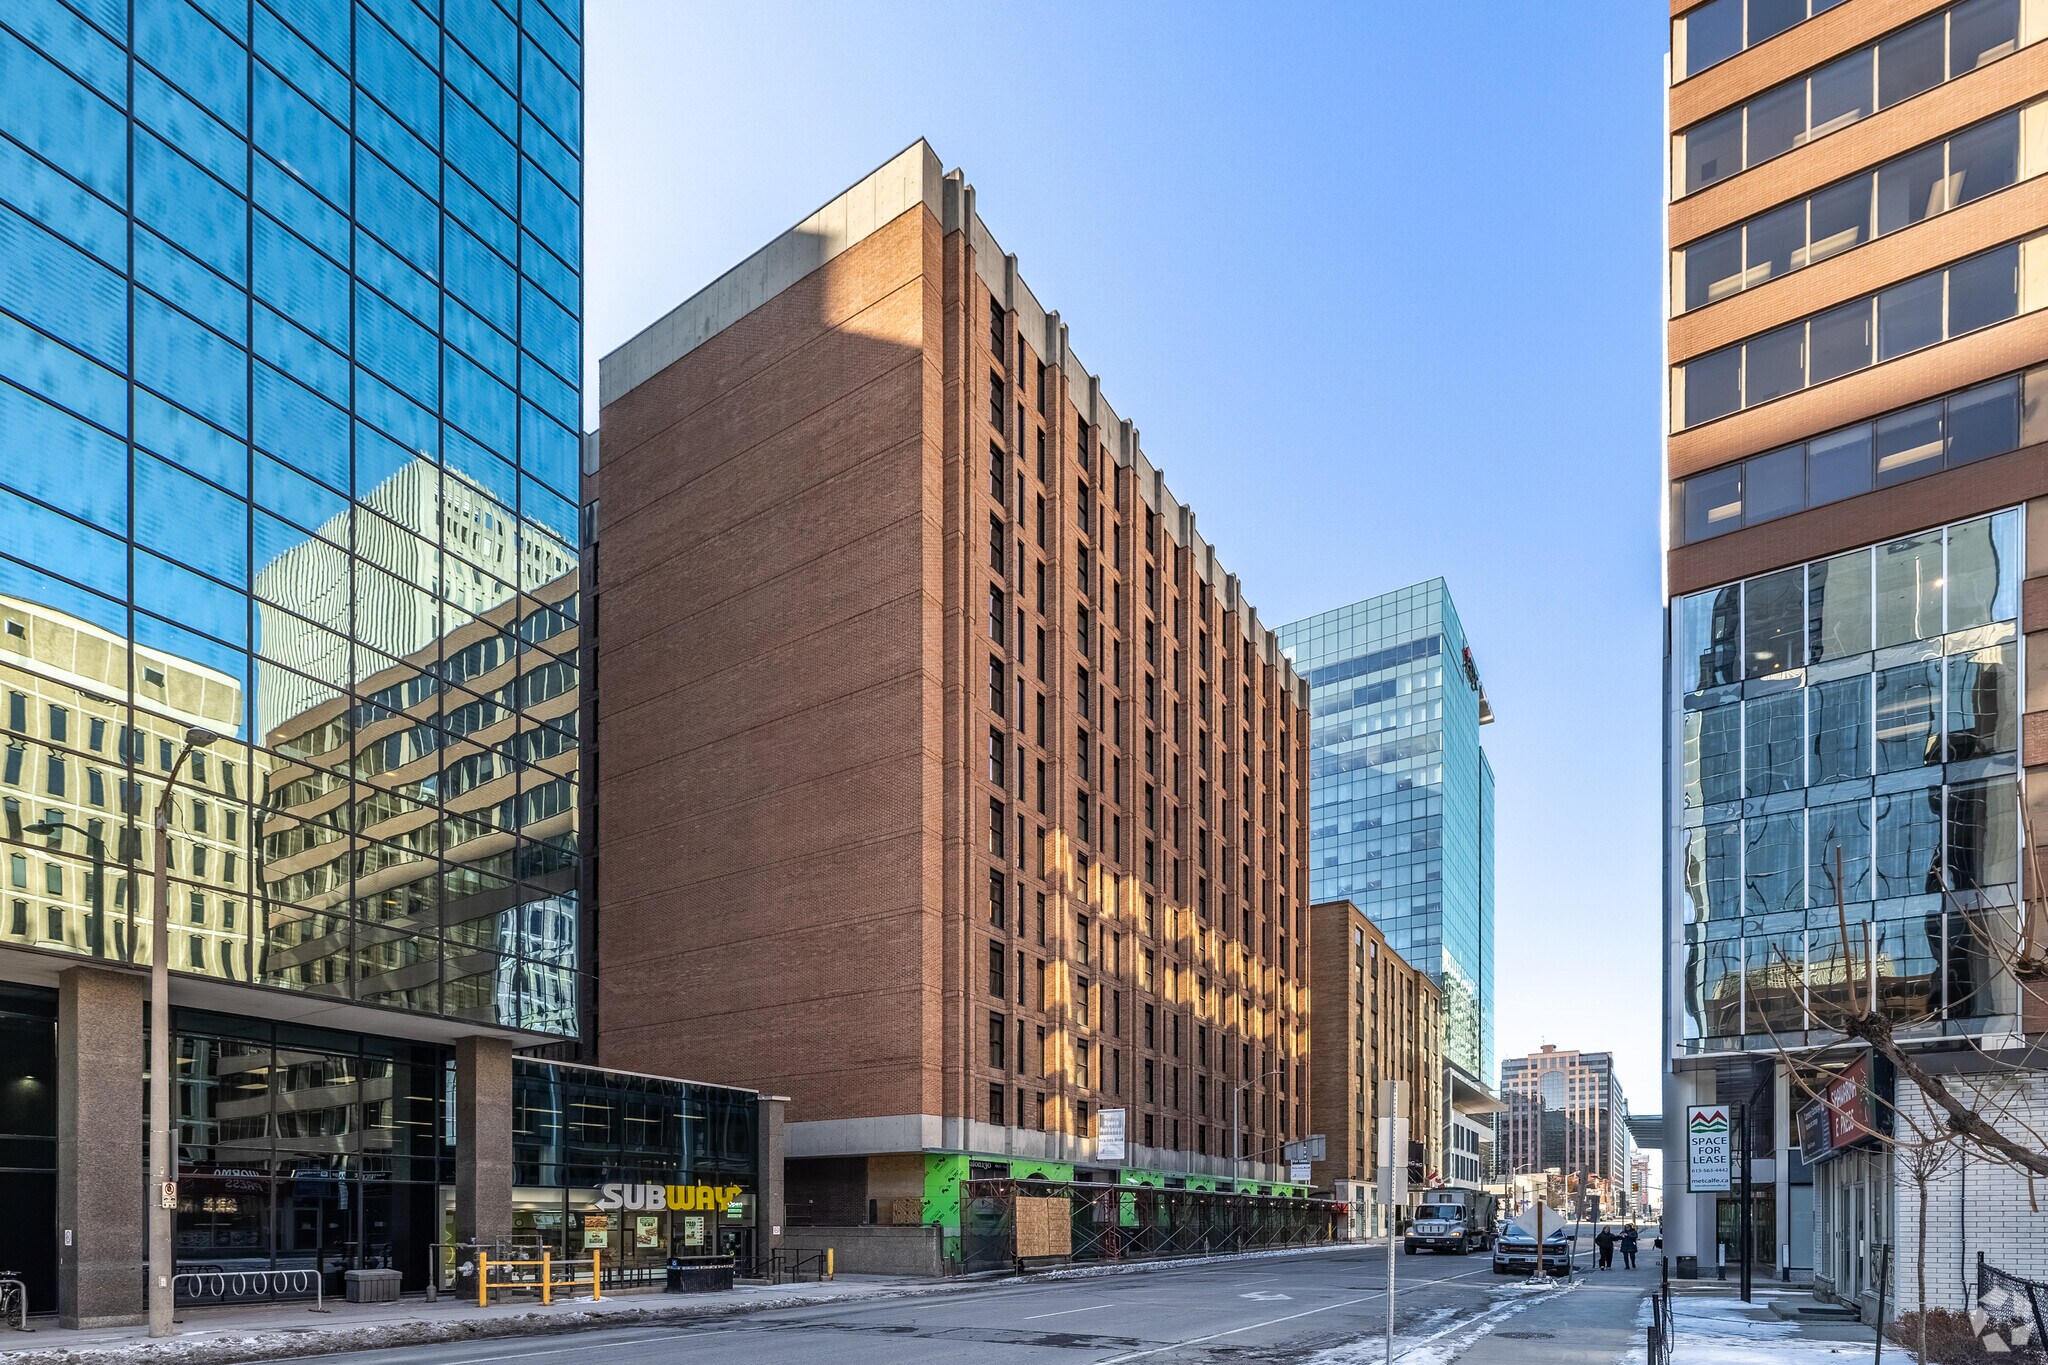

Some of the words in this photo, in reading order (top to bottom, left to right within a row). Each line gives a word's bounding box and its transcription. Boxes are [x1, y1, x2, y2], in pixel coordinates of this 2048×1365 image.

[1692, 1136, 1727, 1146] SPACE
[1698, 1146, 1721, 1155] FOR
[1693, 1155, 1727, 1164] LEASE
[594, 1183, 743, 1212] SUBWAY
